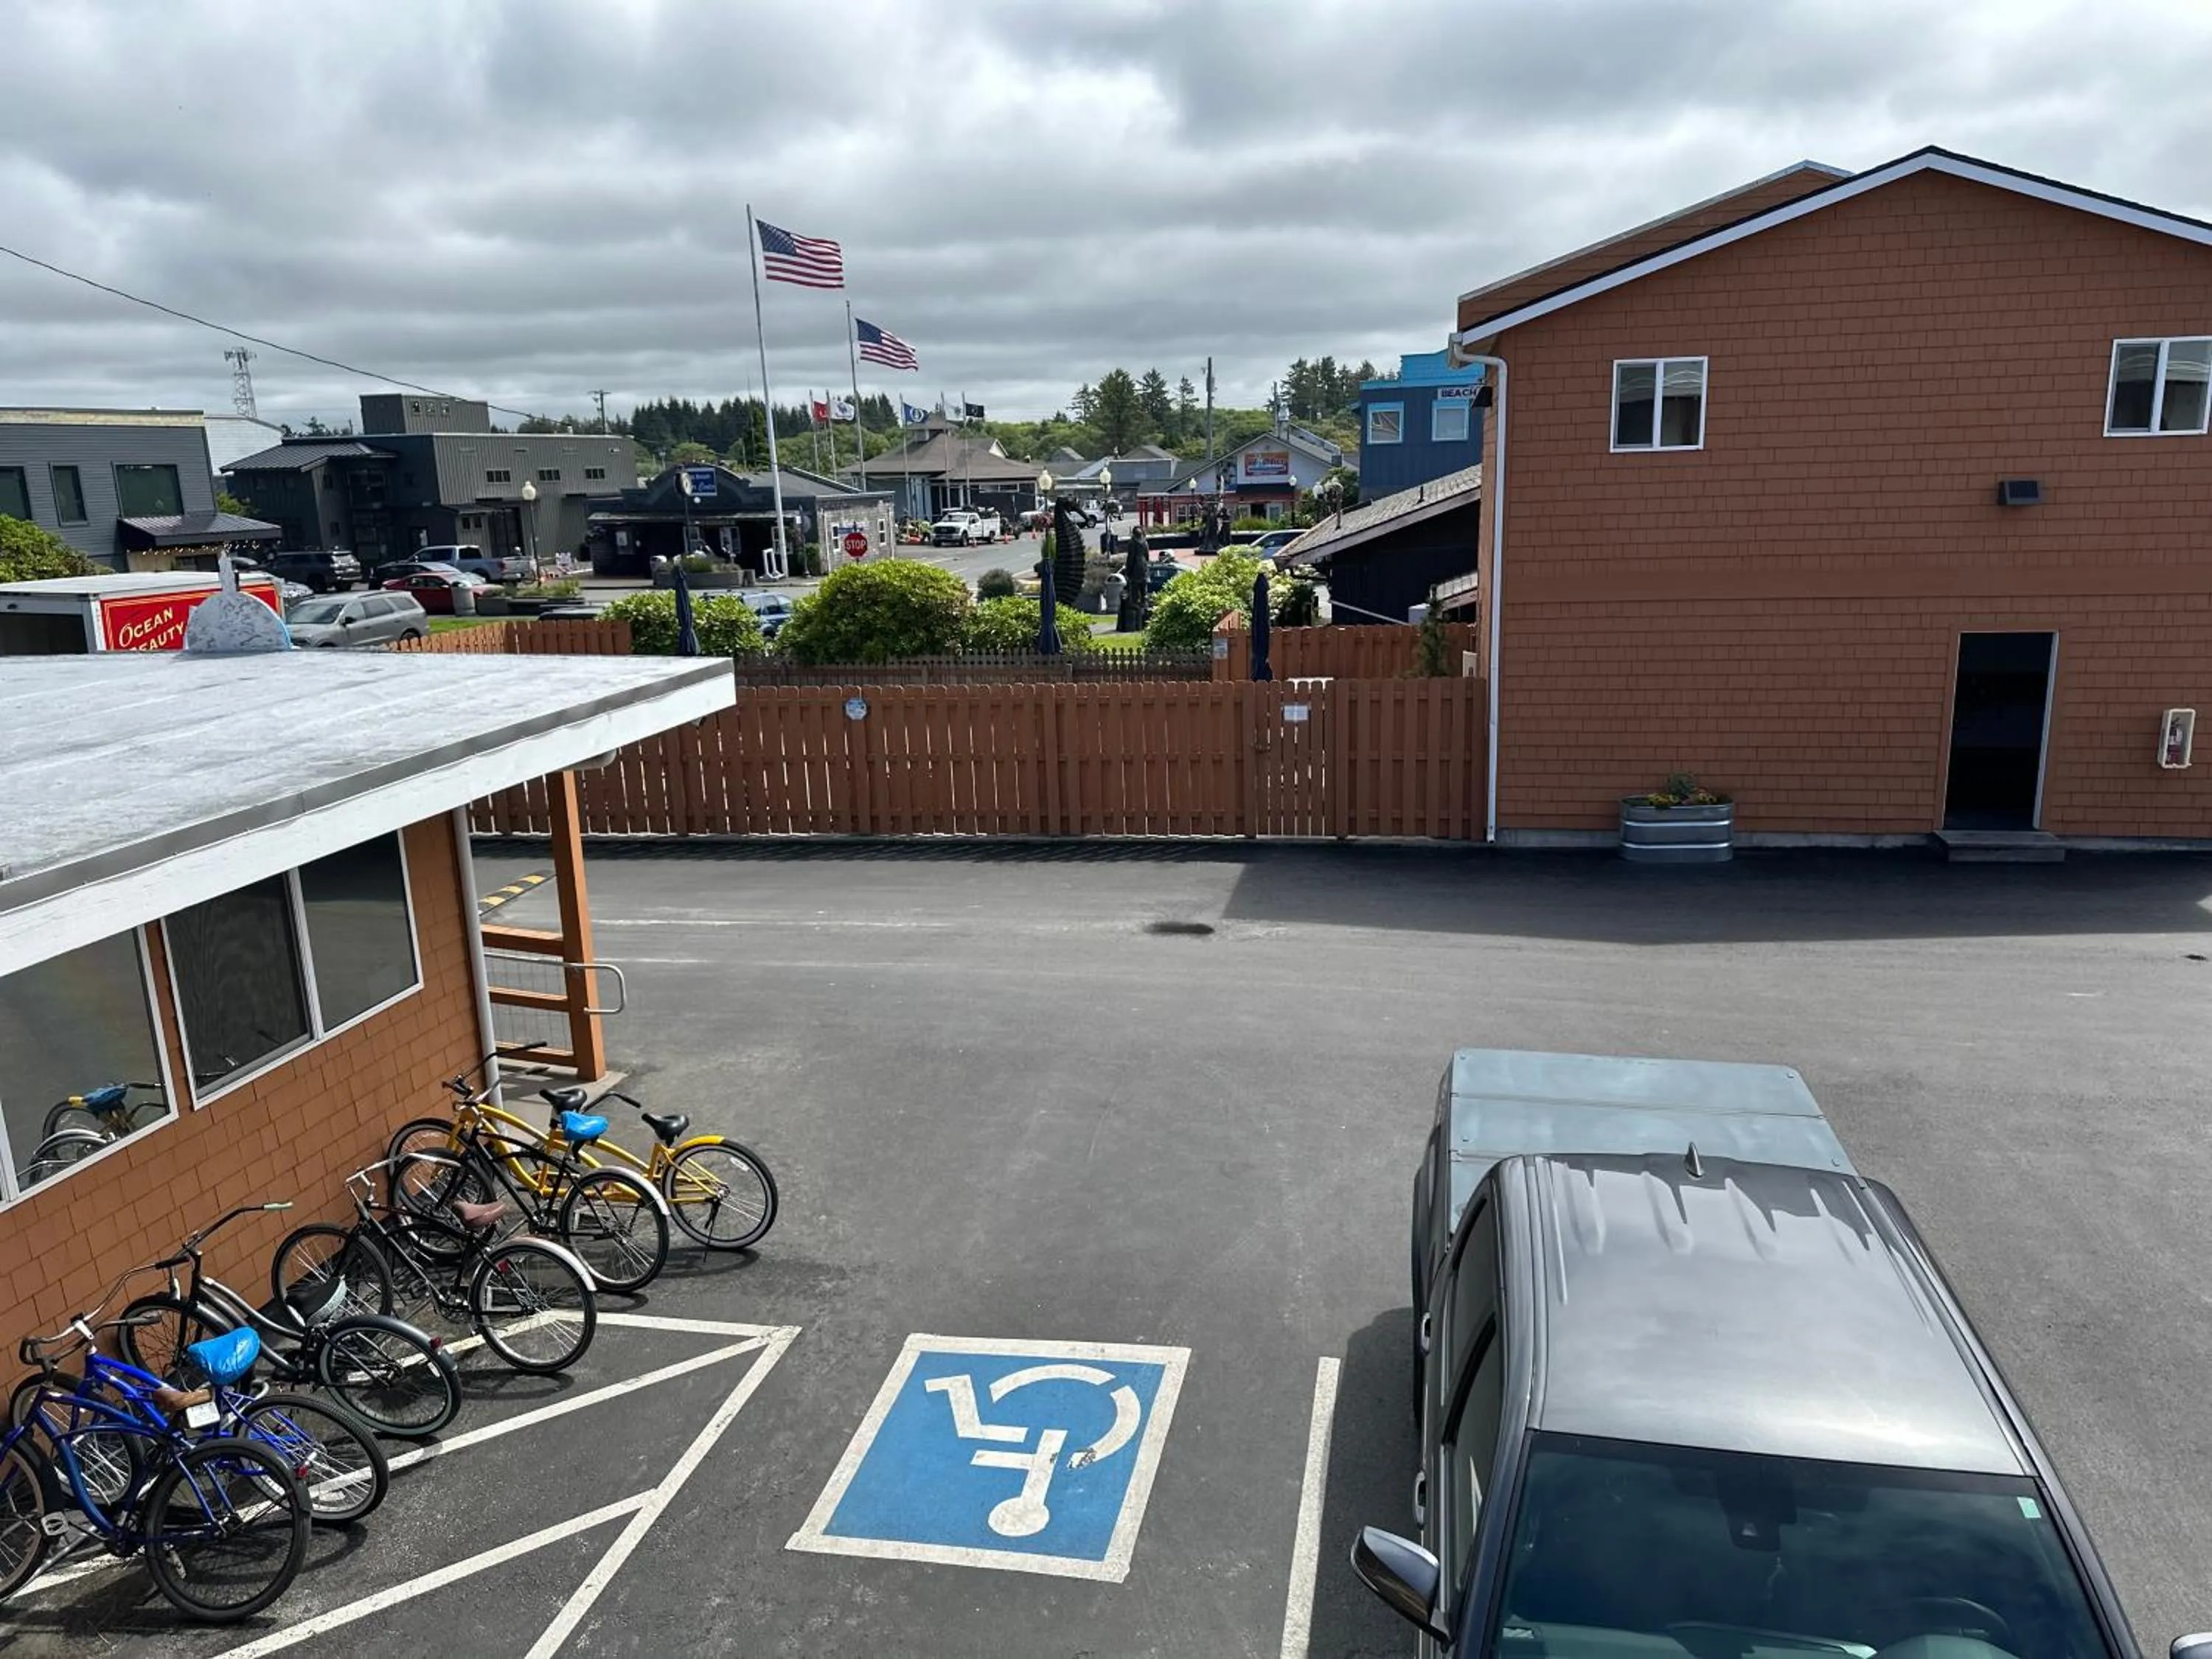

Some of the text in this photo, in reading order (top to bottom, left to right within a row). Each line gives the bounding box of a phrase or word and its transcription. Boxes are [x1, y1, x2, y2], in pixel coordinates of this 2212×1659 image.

[1441, 389, 1477, 397] BEACH
[846, 539, 866, 550] STOP
[119, 607, 173, 647] OCEAN
[129, 622, 184, 650] EAUTY
